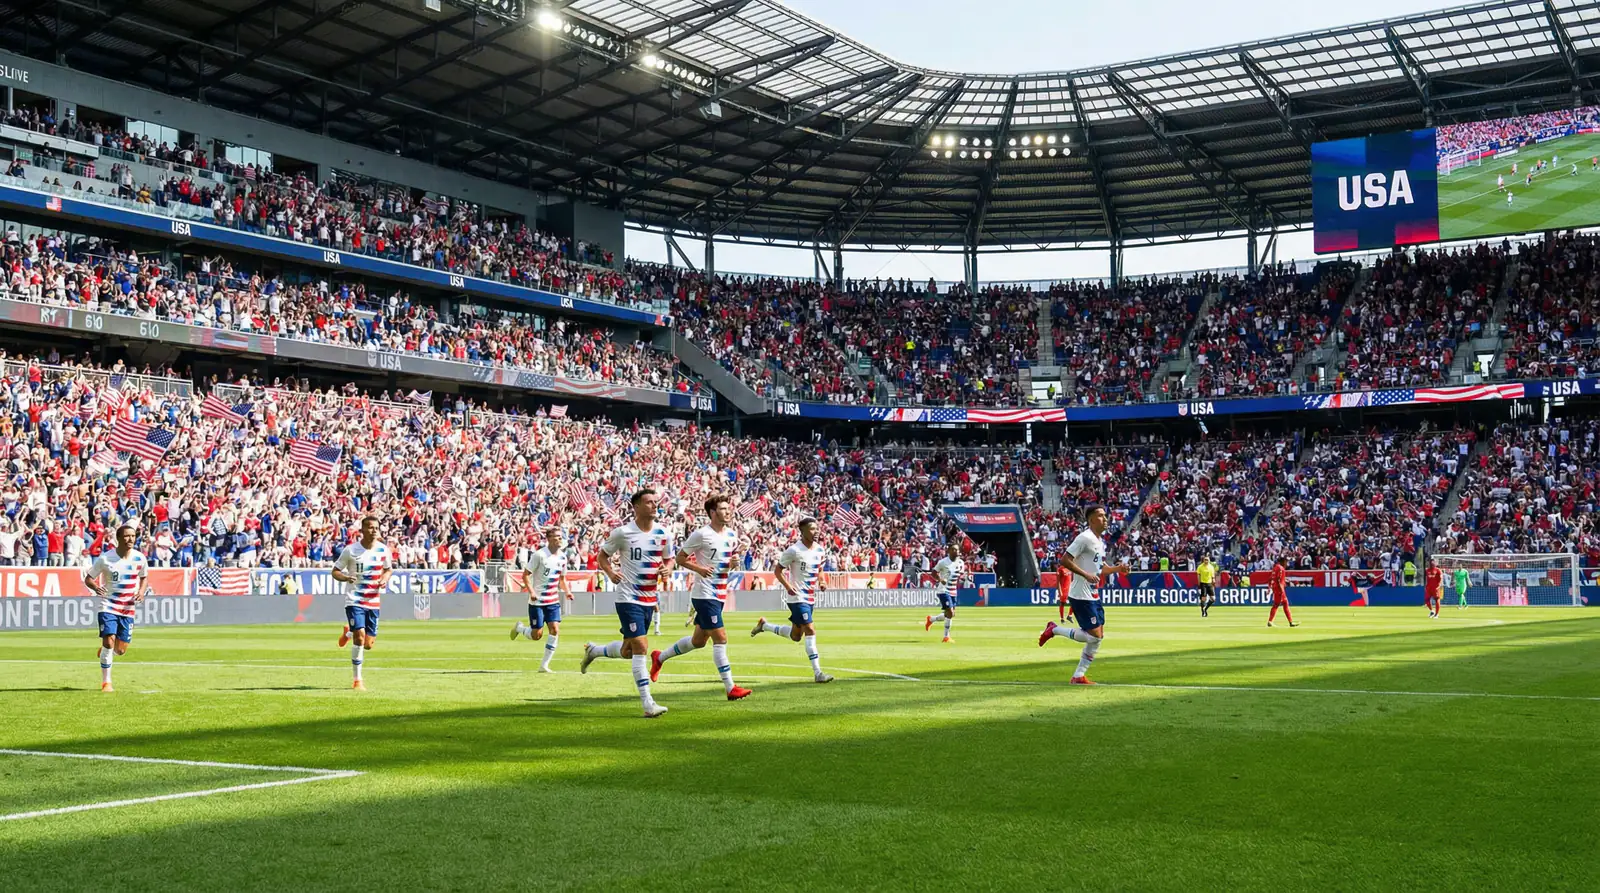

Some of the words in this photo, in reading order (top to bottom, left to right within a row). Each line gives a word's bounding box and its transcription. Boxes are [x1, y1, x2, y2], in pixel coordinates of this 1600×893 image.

[1338, 169, 1415, 211] USA
[171, 221, 192, 236] USA
[323, 250, 341, 265] USA
[450, 275, 465, 288] USA
[560, 296, 574, 309] USA
[380, 353, 402, 370] USA
[1552, 380, 1581, 396] USA
[698, 397, 713, 412] USA
[784, 400, 801, 416] USA
[1190, 401, 1215, 416] USA
[630, 547, 642, 561] 10
[710, 548, 718, 560] 7
[356, 562, 364, 573] 11
[867, 590, 900, 607] SOCCER
[1160, 588, 1201, 605] SOCC
[0, 599, 21, 628] N
[28, 599, 94, 627] FITOS
